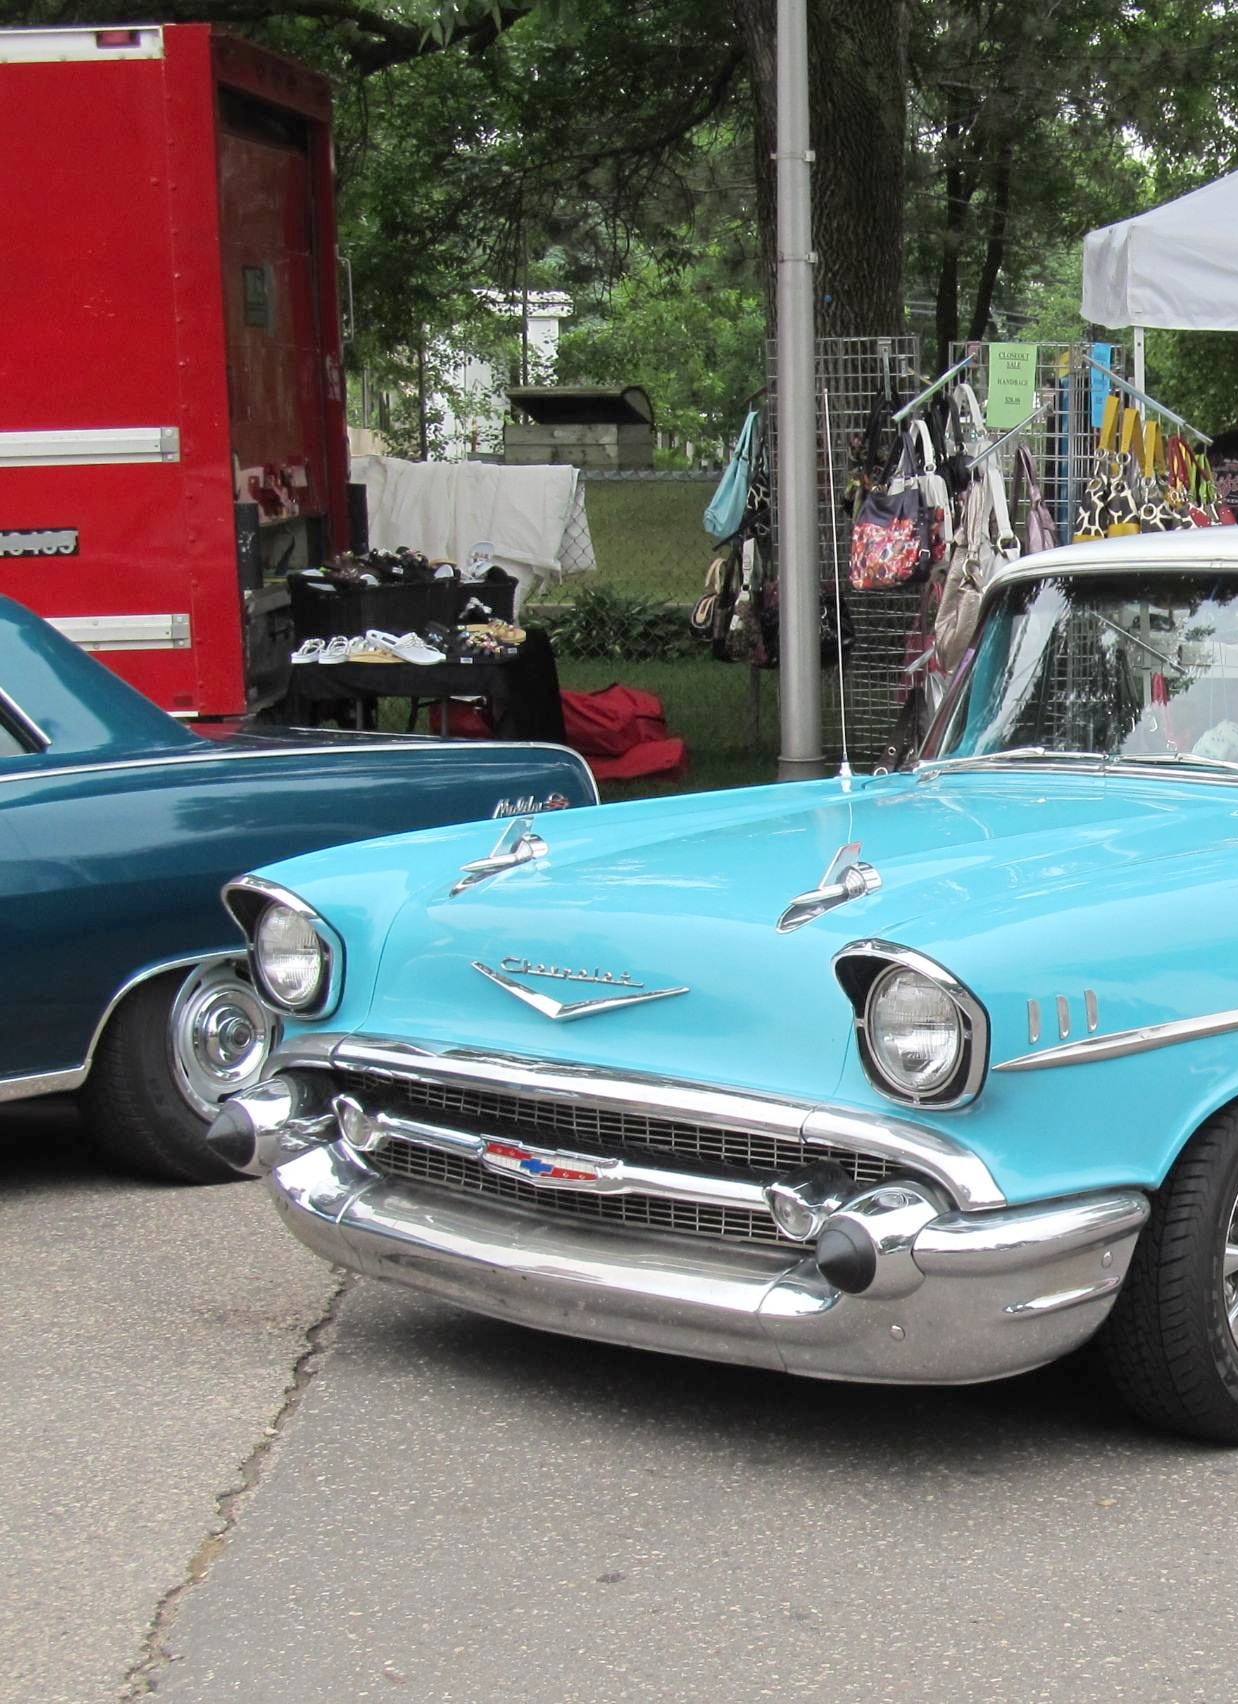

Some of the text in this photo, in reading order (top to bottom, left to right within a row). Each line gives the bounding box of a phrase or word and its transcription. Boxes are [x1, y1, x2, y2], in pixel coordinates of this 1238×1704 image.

[998, 351, 1030, 361] CLOSEOUT
[1006, 361, 1021, 369] SALE
[501, 955, 644, 987] Chevrolet
